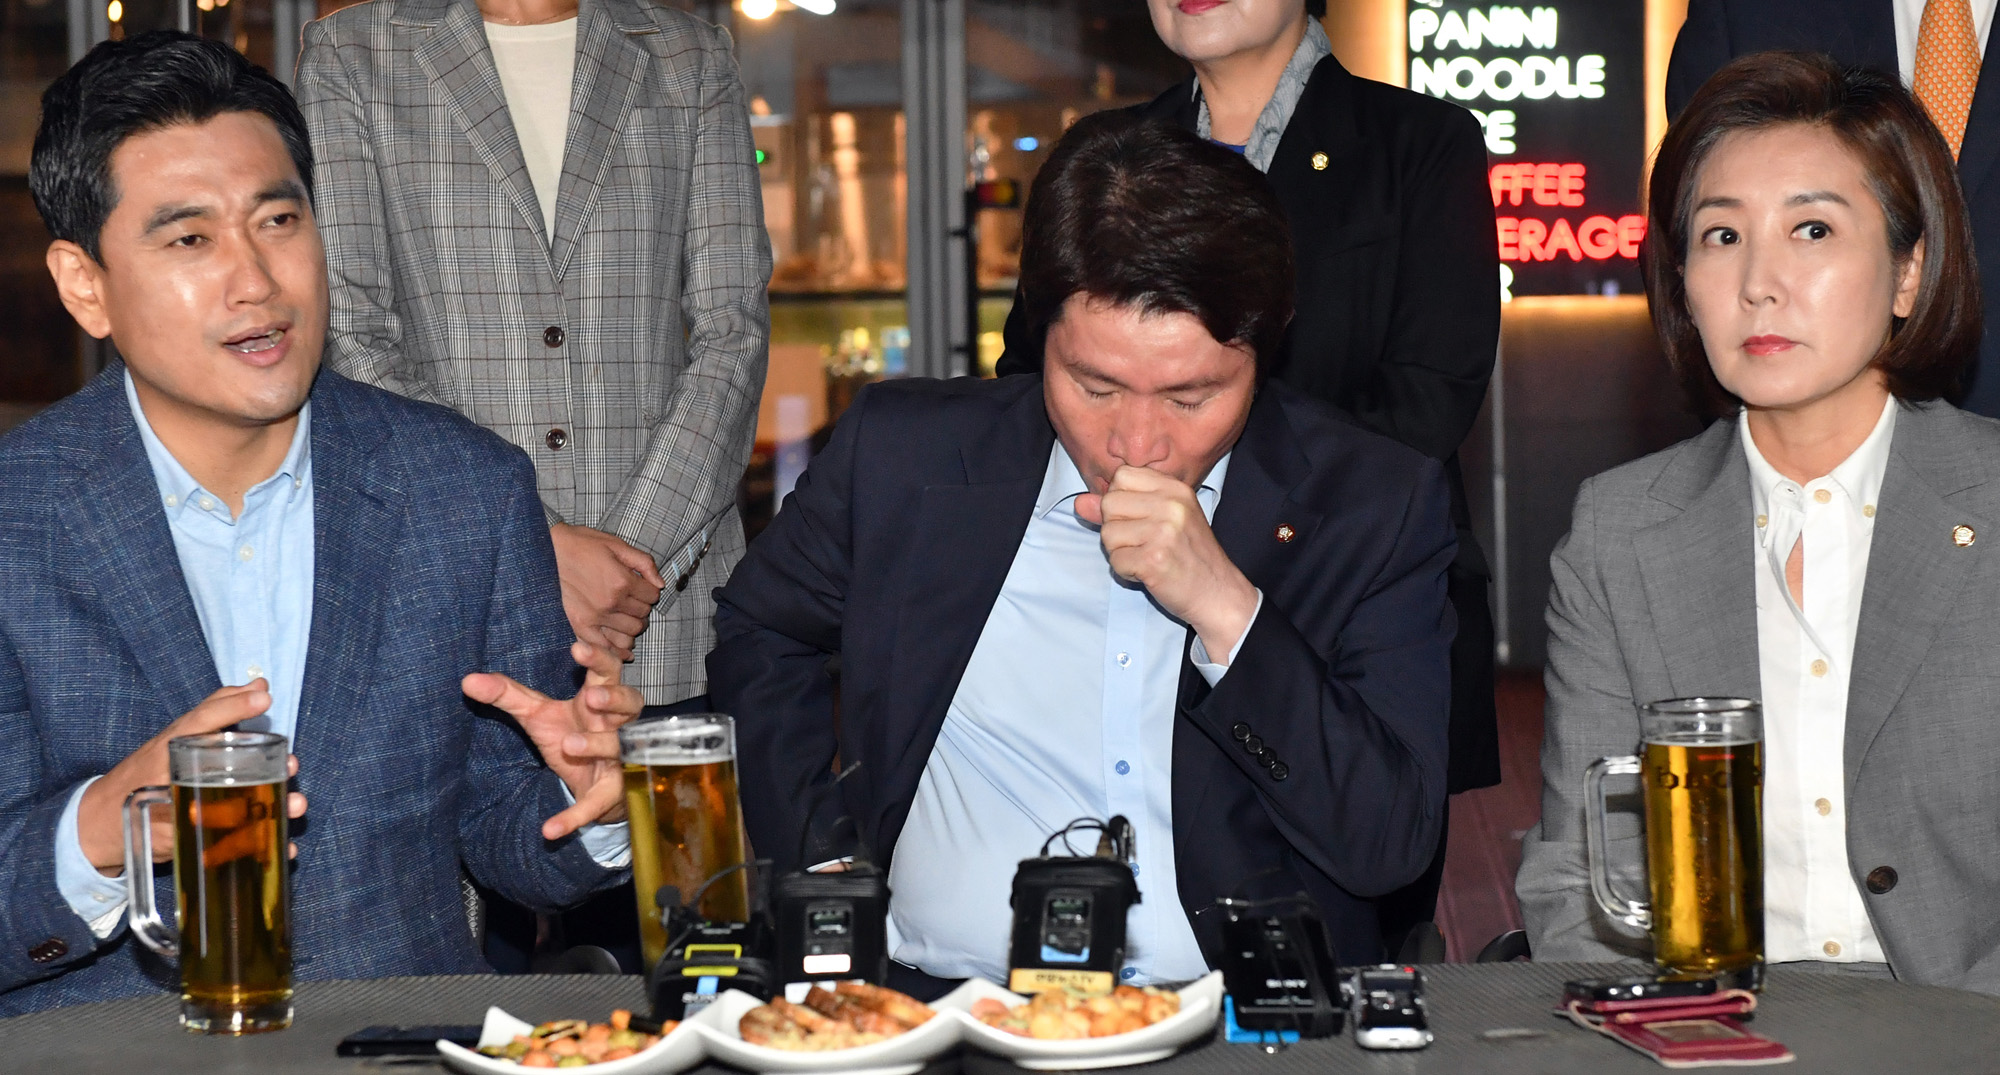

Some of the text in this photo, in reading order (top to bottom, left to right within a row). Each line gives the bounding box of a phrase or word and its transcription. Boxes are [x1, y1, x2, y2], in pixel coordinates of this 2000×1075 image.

[1409, 6, 1558, 52] PANINI
[1411, 55, 1606, 101] NOODLE
[1489, 163, 1586, 207] FFEE
[1496, 215, 1648, 262] ERAGE
